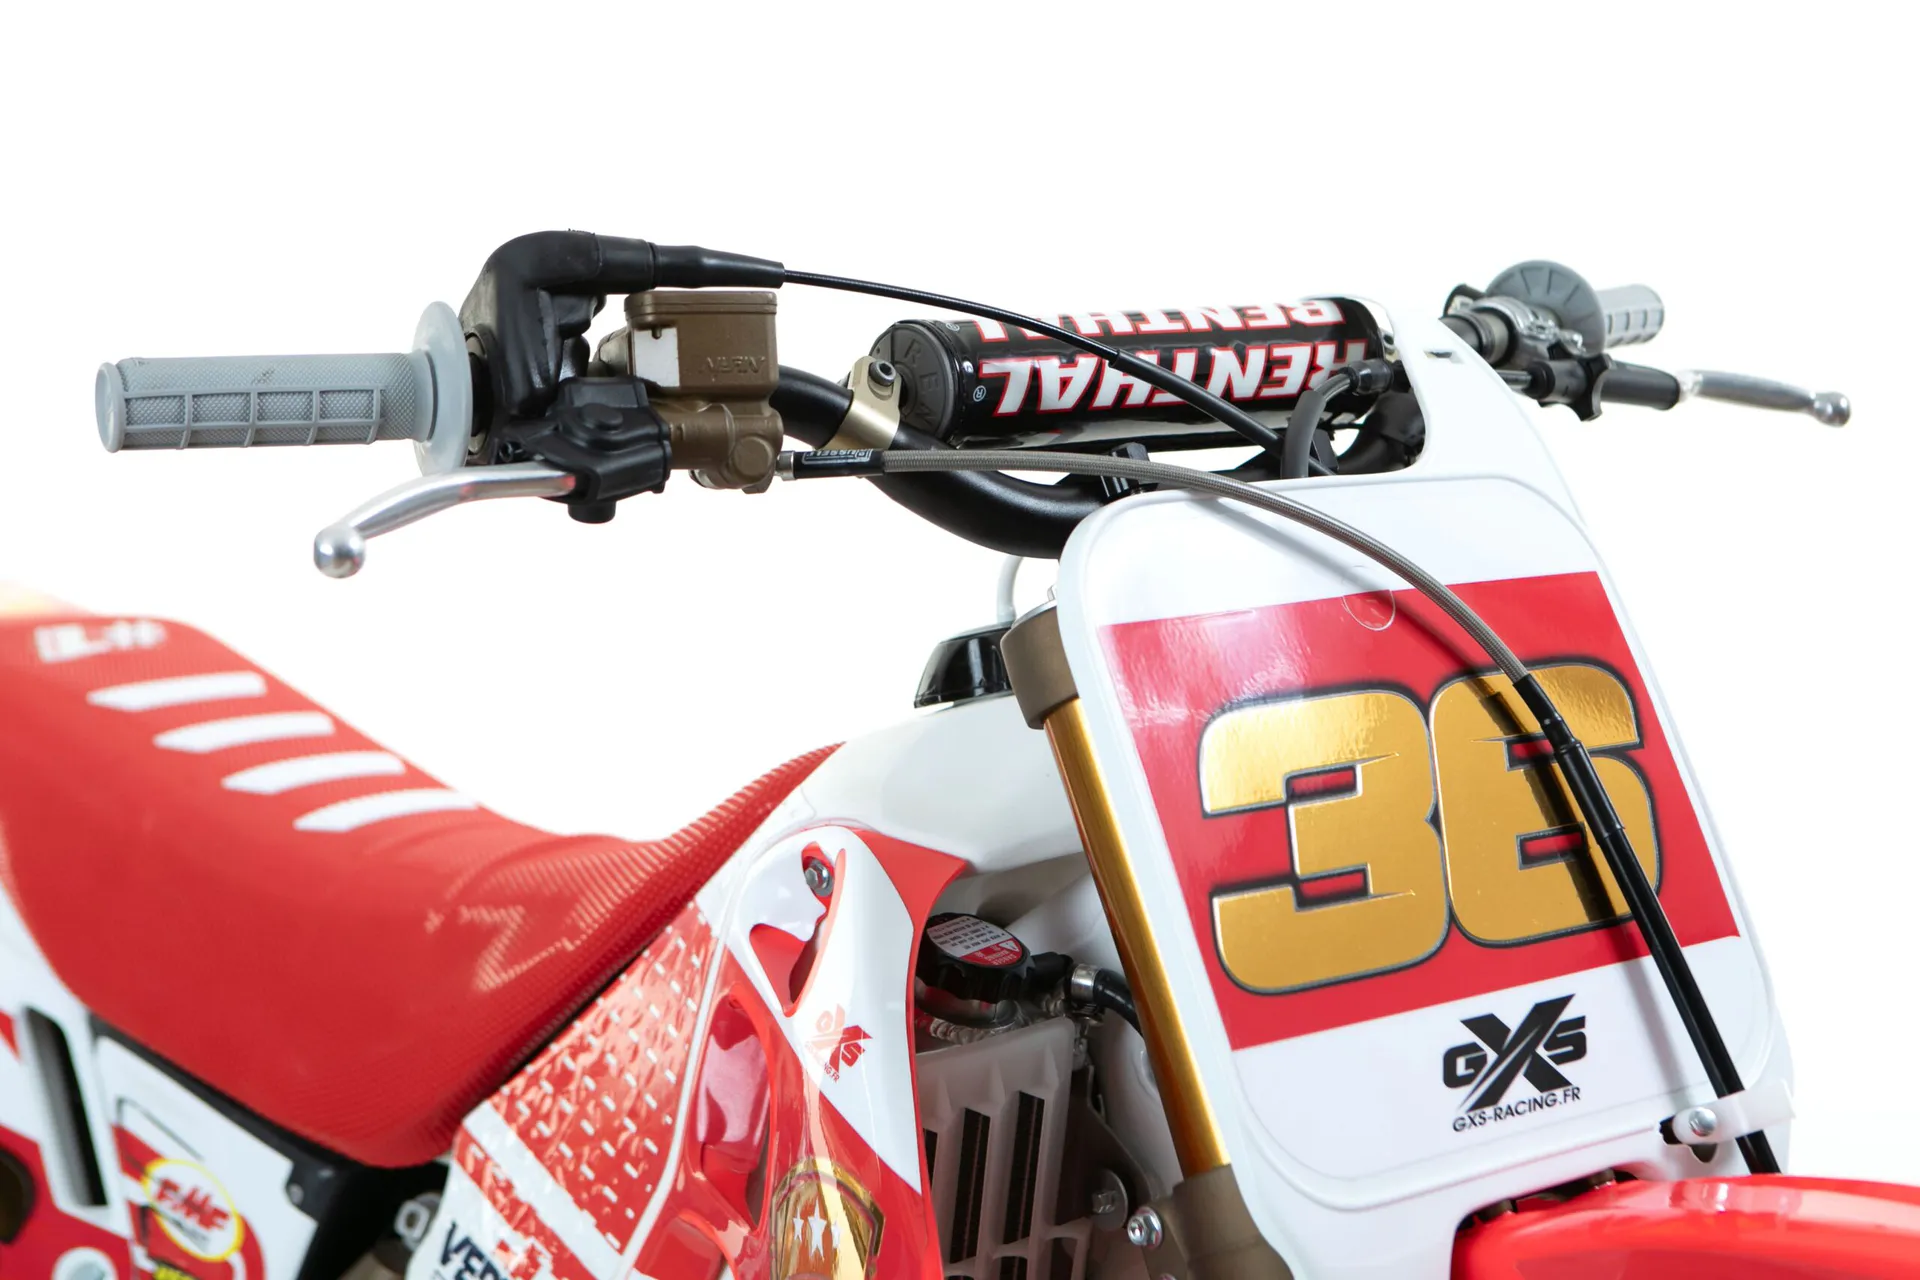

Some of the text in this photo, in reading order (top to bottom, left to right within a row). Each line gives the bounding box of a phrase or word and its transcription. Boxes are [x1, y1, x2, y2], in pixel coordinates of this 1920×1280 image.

[973, 300, 1346, 343] RENTH
[979, 339, 1369, 417] RENTHAL
[1198, 655, 1663, 996] 36
[1443, 993, 1587, 1113] GXS
[1452, 1086, 1581, 1132] GXS-RACING.FR
